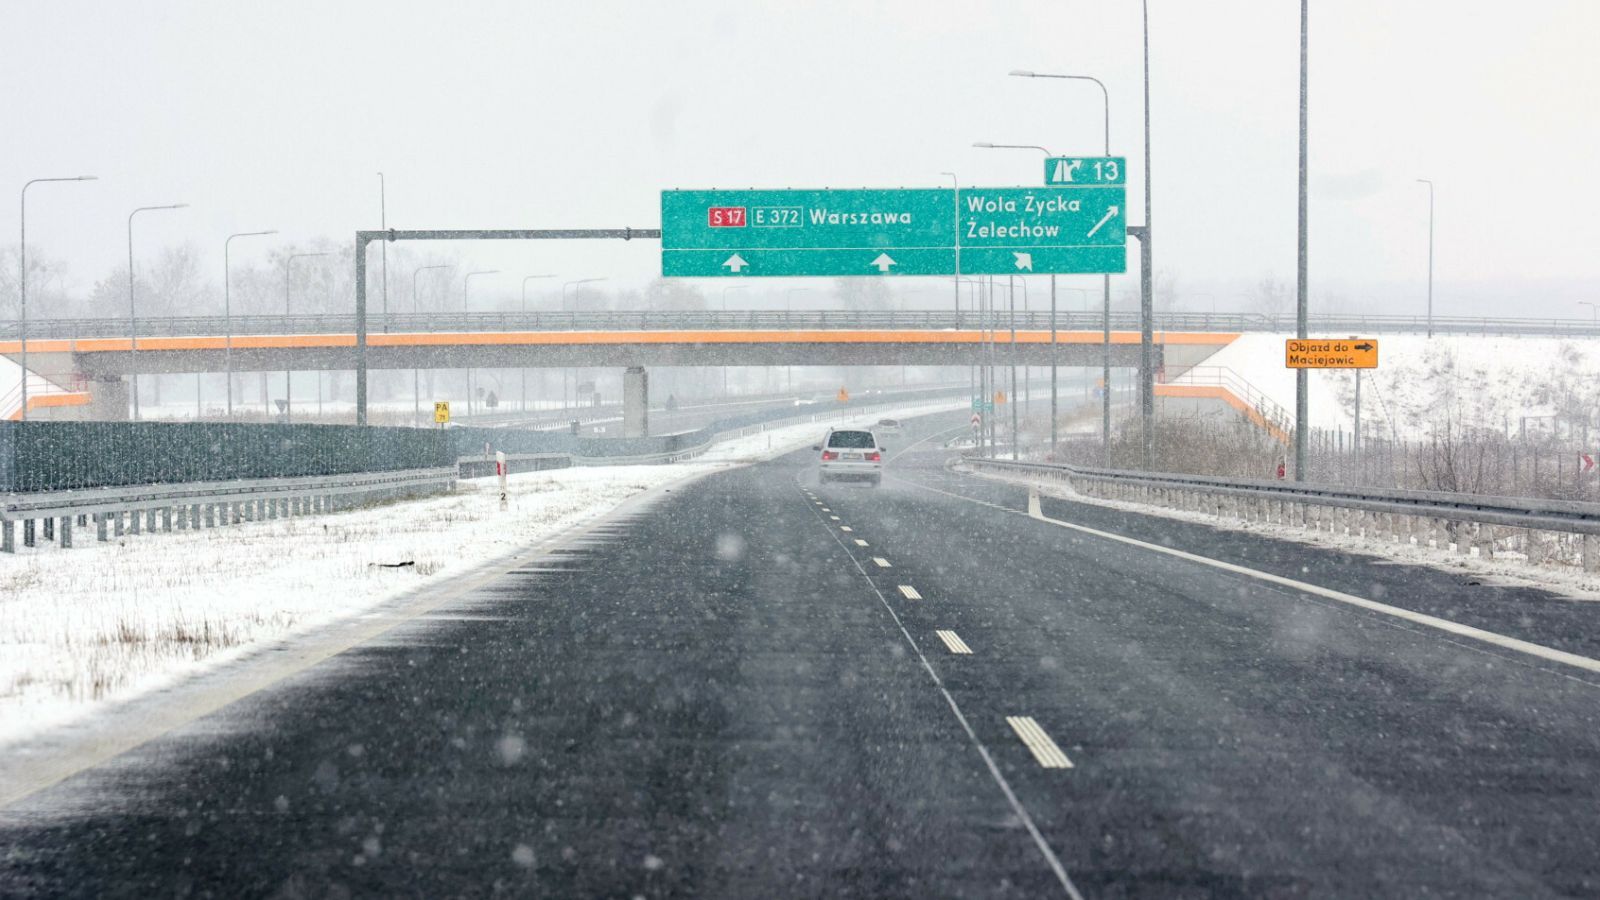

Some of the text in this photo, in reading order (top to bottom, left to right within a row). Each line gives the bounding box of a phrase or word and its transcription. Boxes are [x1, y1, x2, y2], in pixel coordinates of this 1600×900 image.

[1093, 160, 1119, 181] 13
[967, 191, 1081, 216] Wola Życka
[713, 210, 742, 224] S 17
[756, 210, 799, 224] E 372
[809, 208, 912, 225] Warszawa
[966, 217, 1060, 238] Żelechów
[1289, 342, 1349, 354] Objazd do
[1289, 354, 1355, 367] Maciejowic
[436, 403, 448, 412] PA
[500, 492, 506, 501] 2
